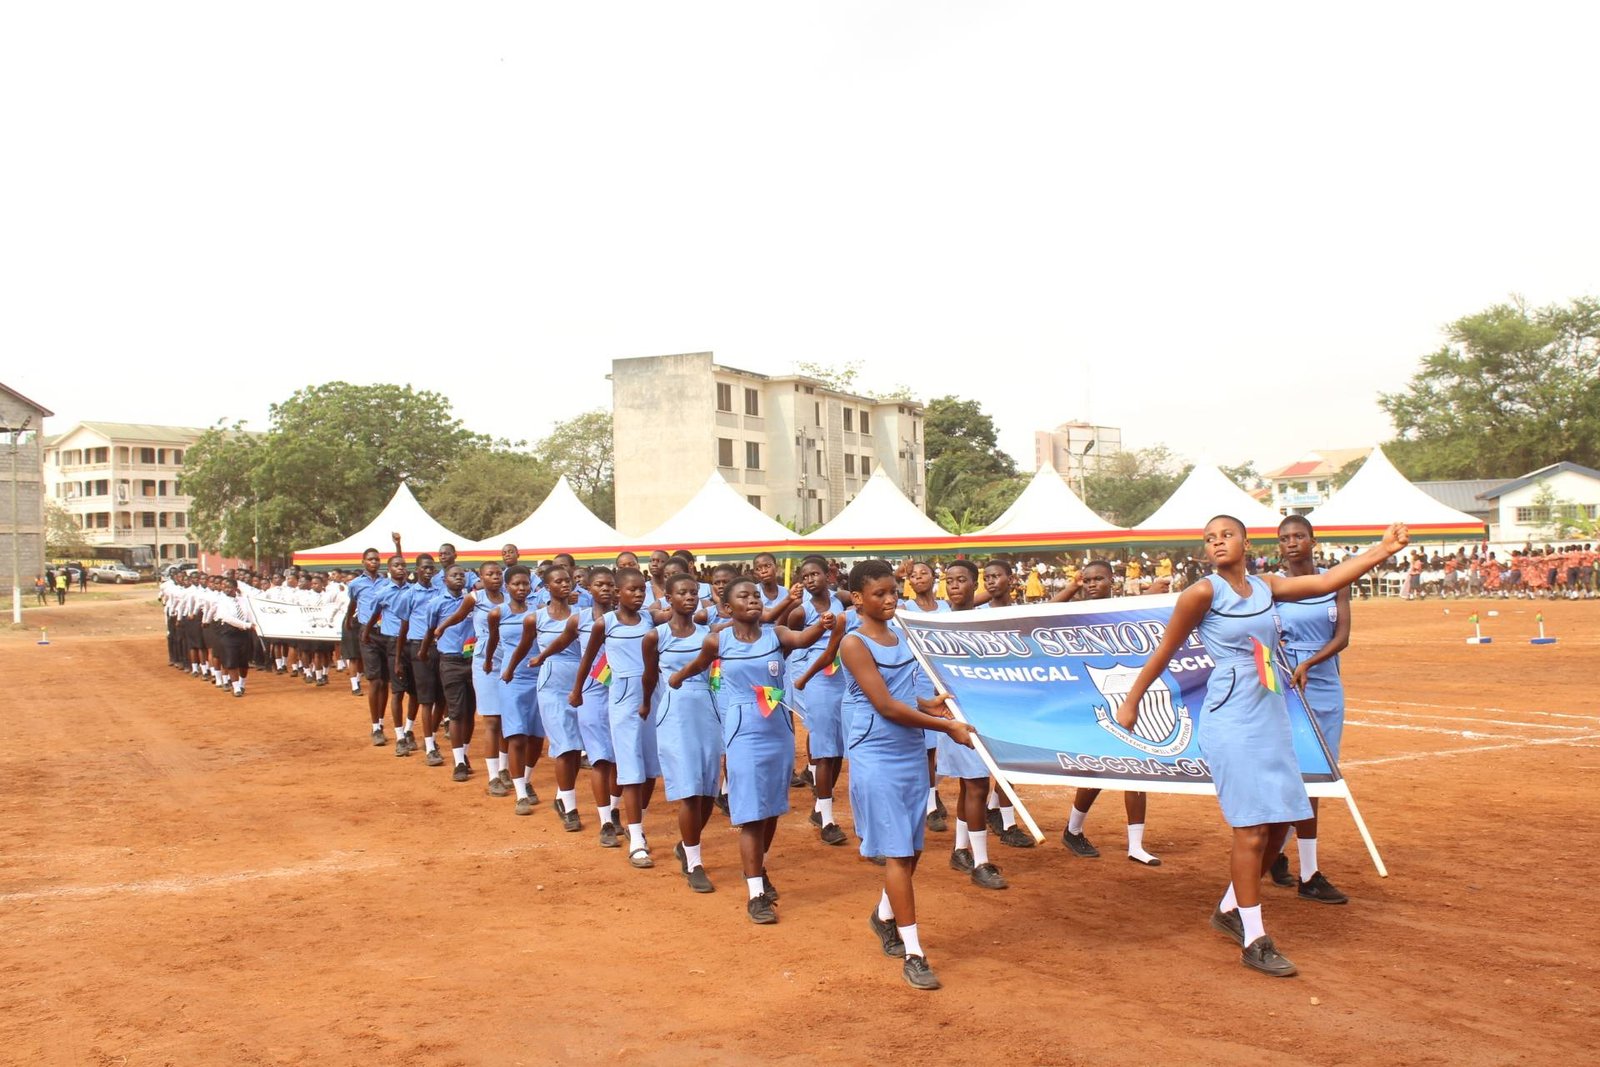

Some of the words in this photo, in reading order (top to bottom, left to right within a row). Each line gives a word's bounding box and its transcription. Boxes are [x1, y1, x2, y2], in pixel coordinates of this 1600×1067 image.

[907, 627, 1032, 658] KINBU
[1031, 620, 1167, 656] SENIOR
[943, 664, 1079, 682] TECHNICAL
